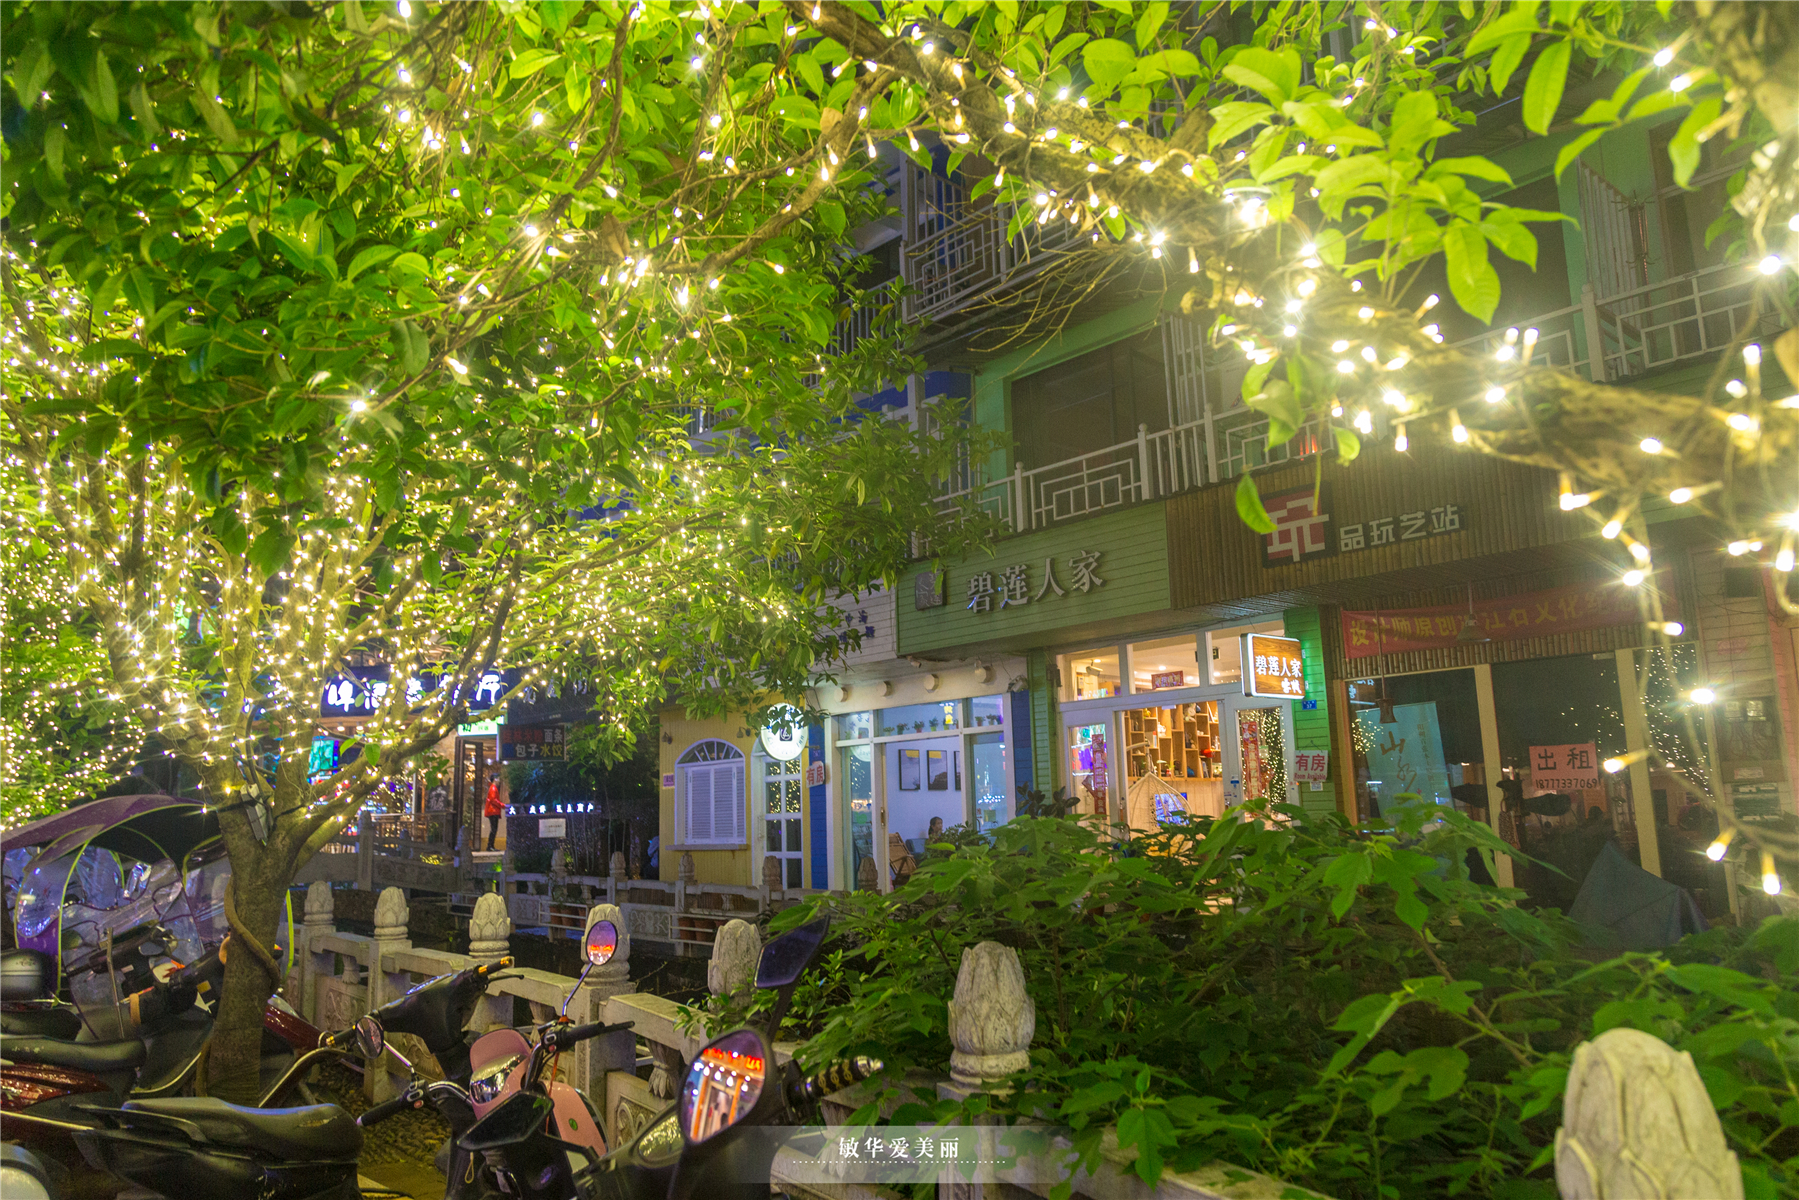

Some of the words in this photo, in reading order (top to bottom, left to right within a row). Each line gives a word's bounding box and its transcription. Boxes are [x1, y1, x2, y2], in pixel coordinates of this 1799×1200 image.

[1339, 504, 1461, 552] 品玩艺站
[966, 550, 1104, 614] 碧莲人家
[1255, 655, 1302, 678] 碧莲人家
[515, 743, 563, 758] 包子水饺
[1537, 747, 1594, 771] 出租
[1295, 753, 1326, 772] 有房
[806, 765, 824, 786] 有房
[1535, 778, 1598, 789] 18777337069
